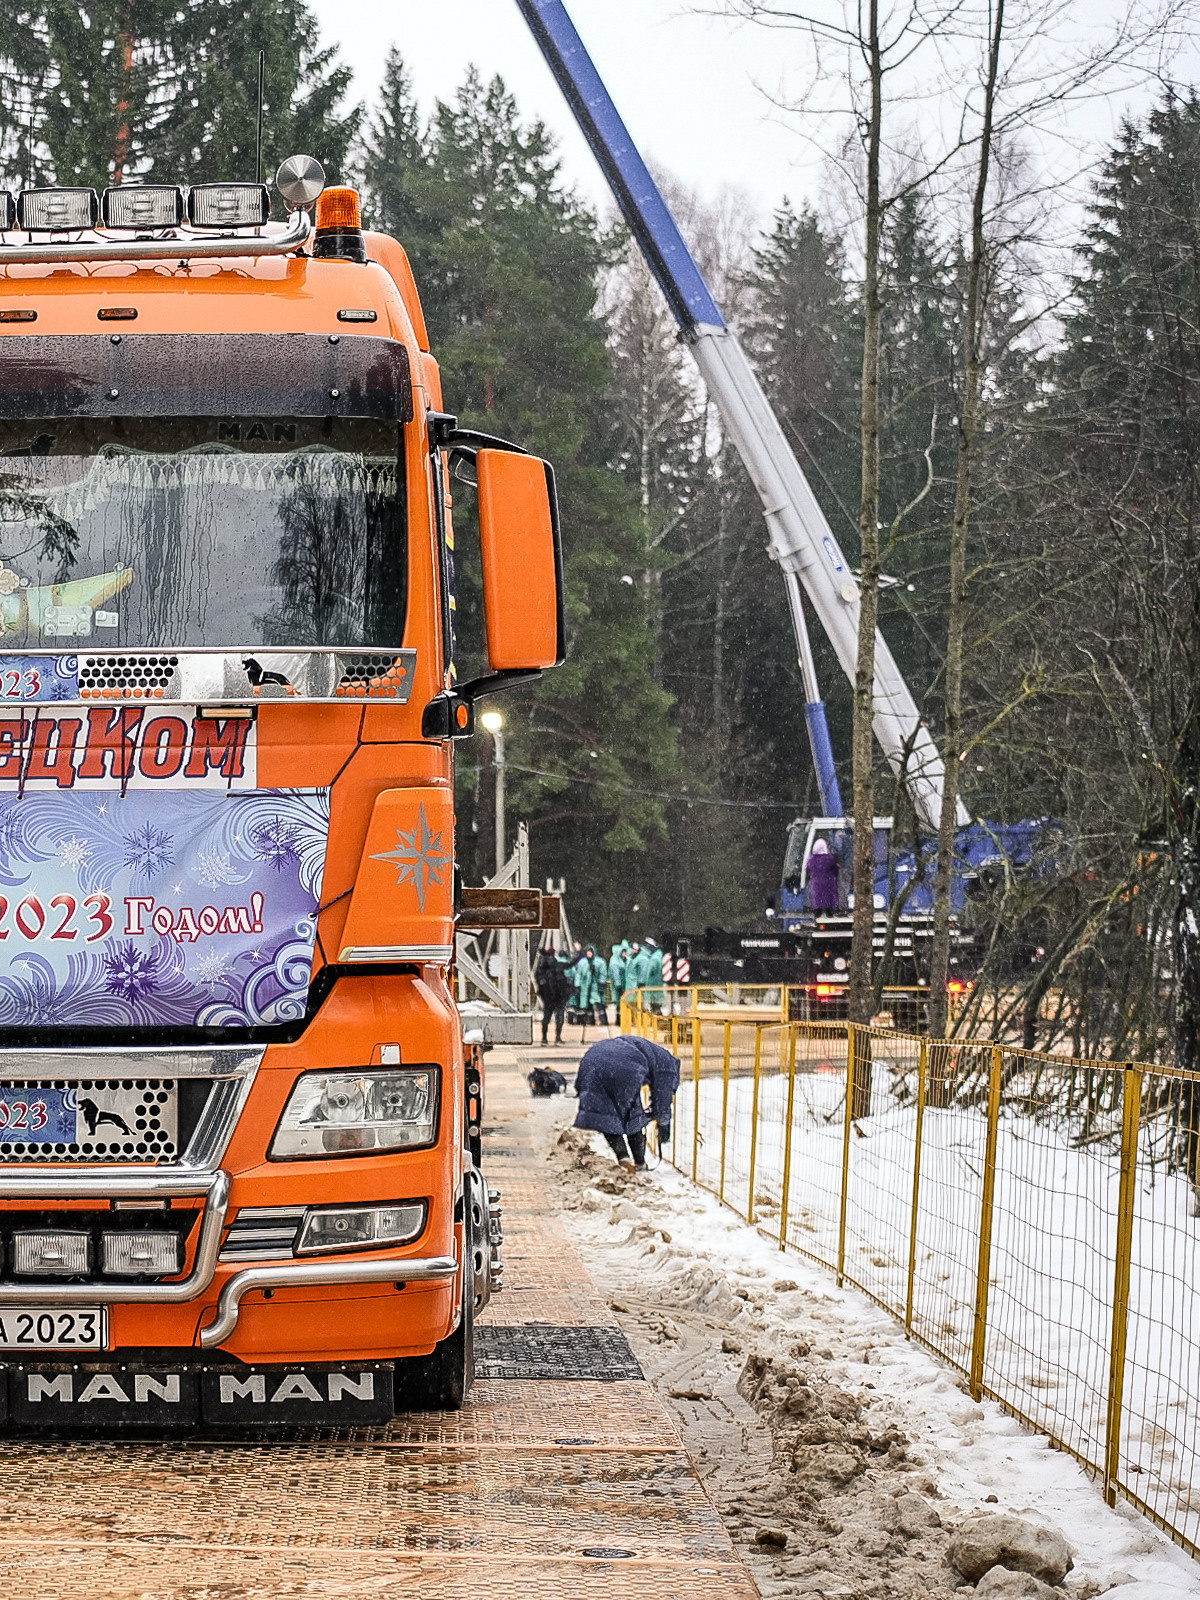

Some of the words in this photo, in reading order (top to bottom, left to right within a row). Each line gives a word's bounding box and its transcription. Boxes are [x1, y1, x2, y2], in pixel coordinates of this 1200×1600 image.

[218, 422, 297, 442] MAN
[16, 1314, 96, 1344] 2023
[28, 1374, 180, 1402] MAN
[219, 1373, 374, 1403] MAN
